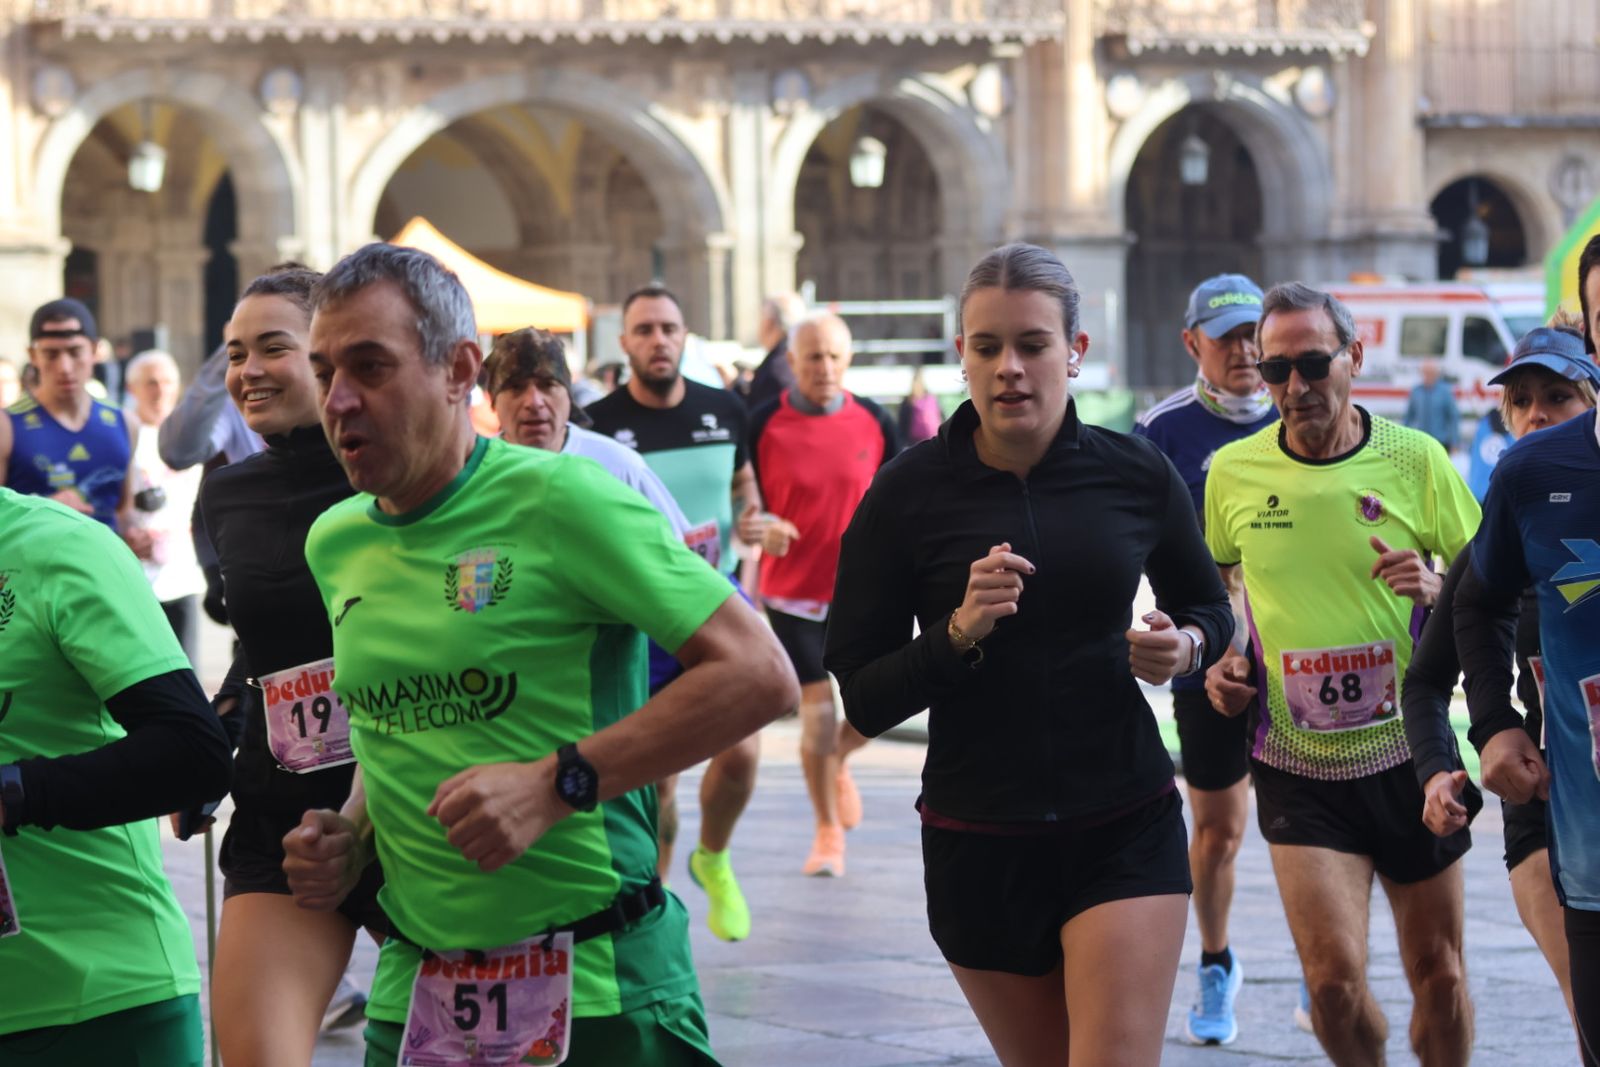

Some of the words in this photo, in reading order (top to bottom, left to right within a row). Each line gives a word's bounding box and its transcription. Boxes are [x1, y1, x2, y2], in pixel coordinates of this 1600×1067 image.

[1257, 509, 1289, 518] VIATOR
[1283, 646, 1393, 676] bedunia
[264, 670, 335, 706] bedu
[1319, 673, 1363, 705] 68
[291, 696, 342, 738] 19
[371, 700, 483, 736] TELECOM
[453, 983, 508, 1032] 51
